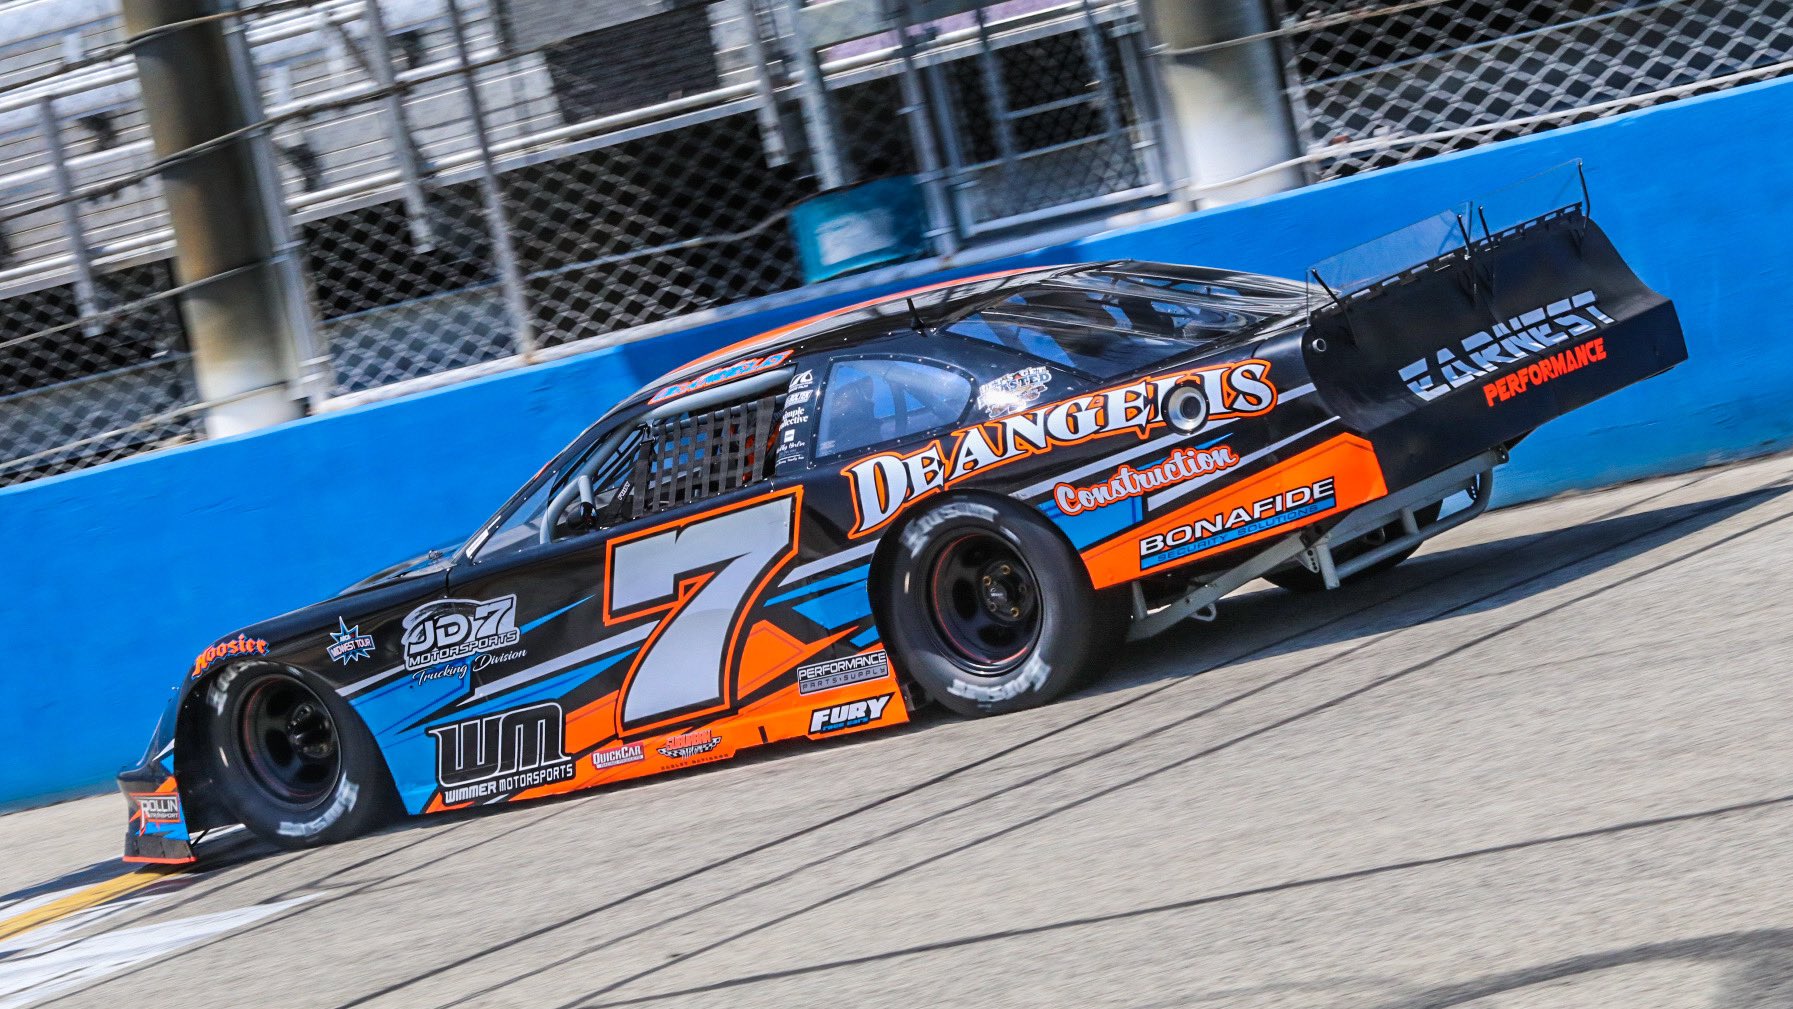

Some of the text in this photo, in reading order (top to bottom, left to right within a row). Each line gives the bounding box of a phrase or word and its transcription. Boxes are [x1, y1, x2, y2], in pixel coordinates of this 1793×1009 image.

[1398, 290, 1615, 402] EARNEST
[1482, 337, 1608, 408] PERFORMANCE
[1053, 445, 1240, 516] Construction
[1140, 478, 1334, 556] BONAFIDE
[1157, 504, 1319, 562] SECURITY SOLUTIONS
[607, 484, 804, 738] 7
[191, 633, 270, 679] Hoosier
[355, 638, 371, 648] TOUR
[408, 630, 518, 667] MOTORSPORTS
[799, 652, 887, 680] PERFORMANCE
[412, 649, 527, 686] Trucking Division
[810, 695, 891, 733] FURY
[445, 763, 573, 803] WIMMER MOTORSPORTS
